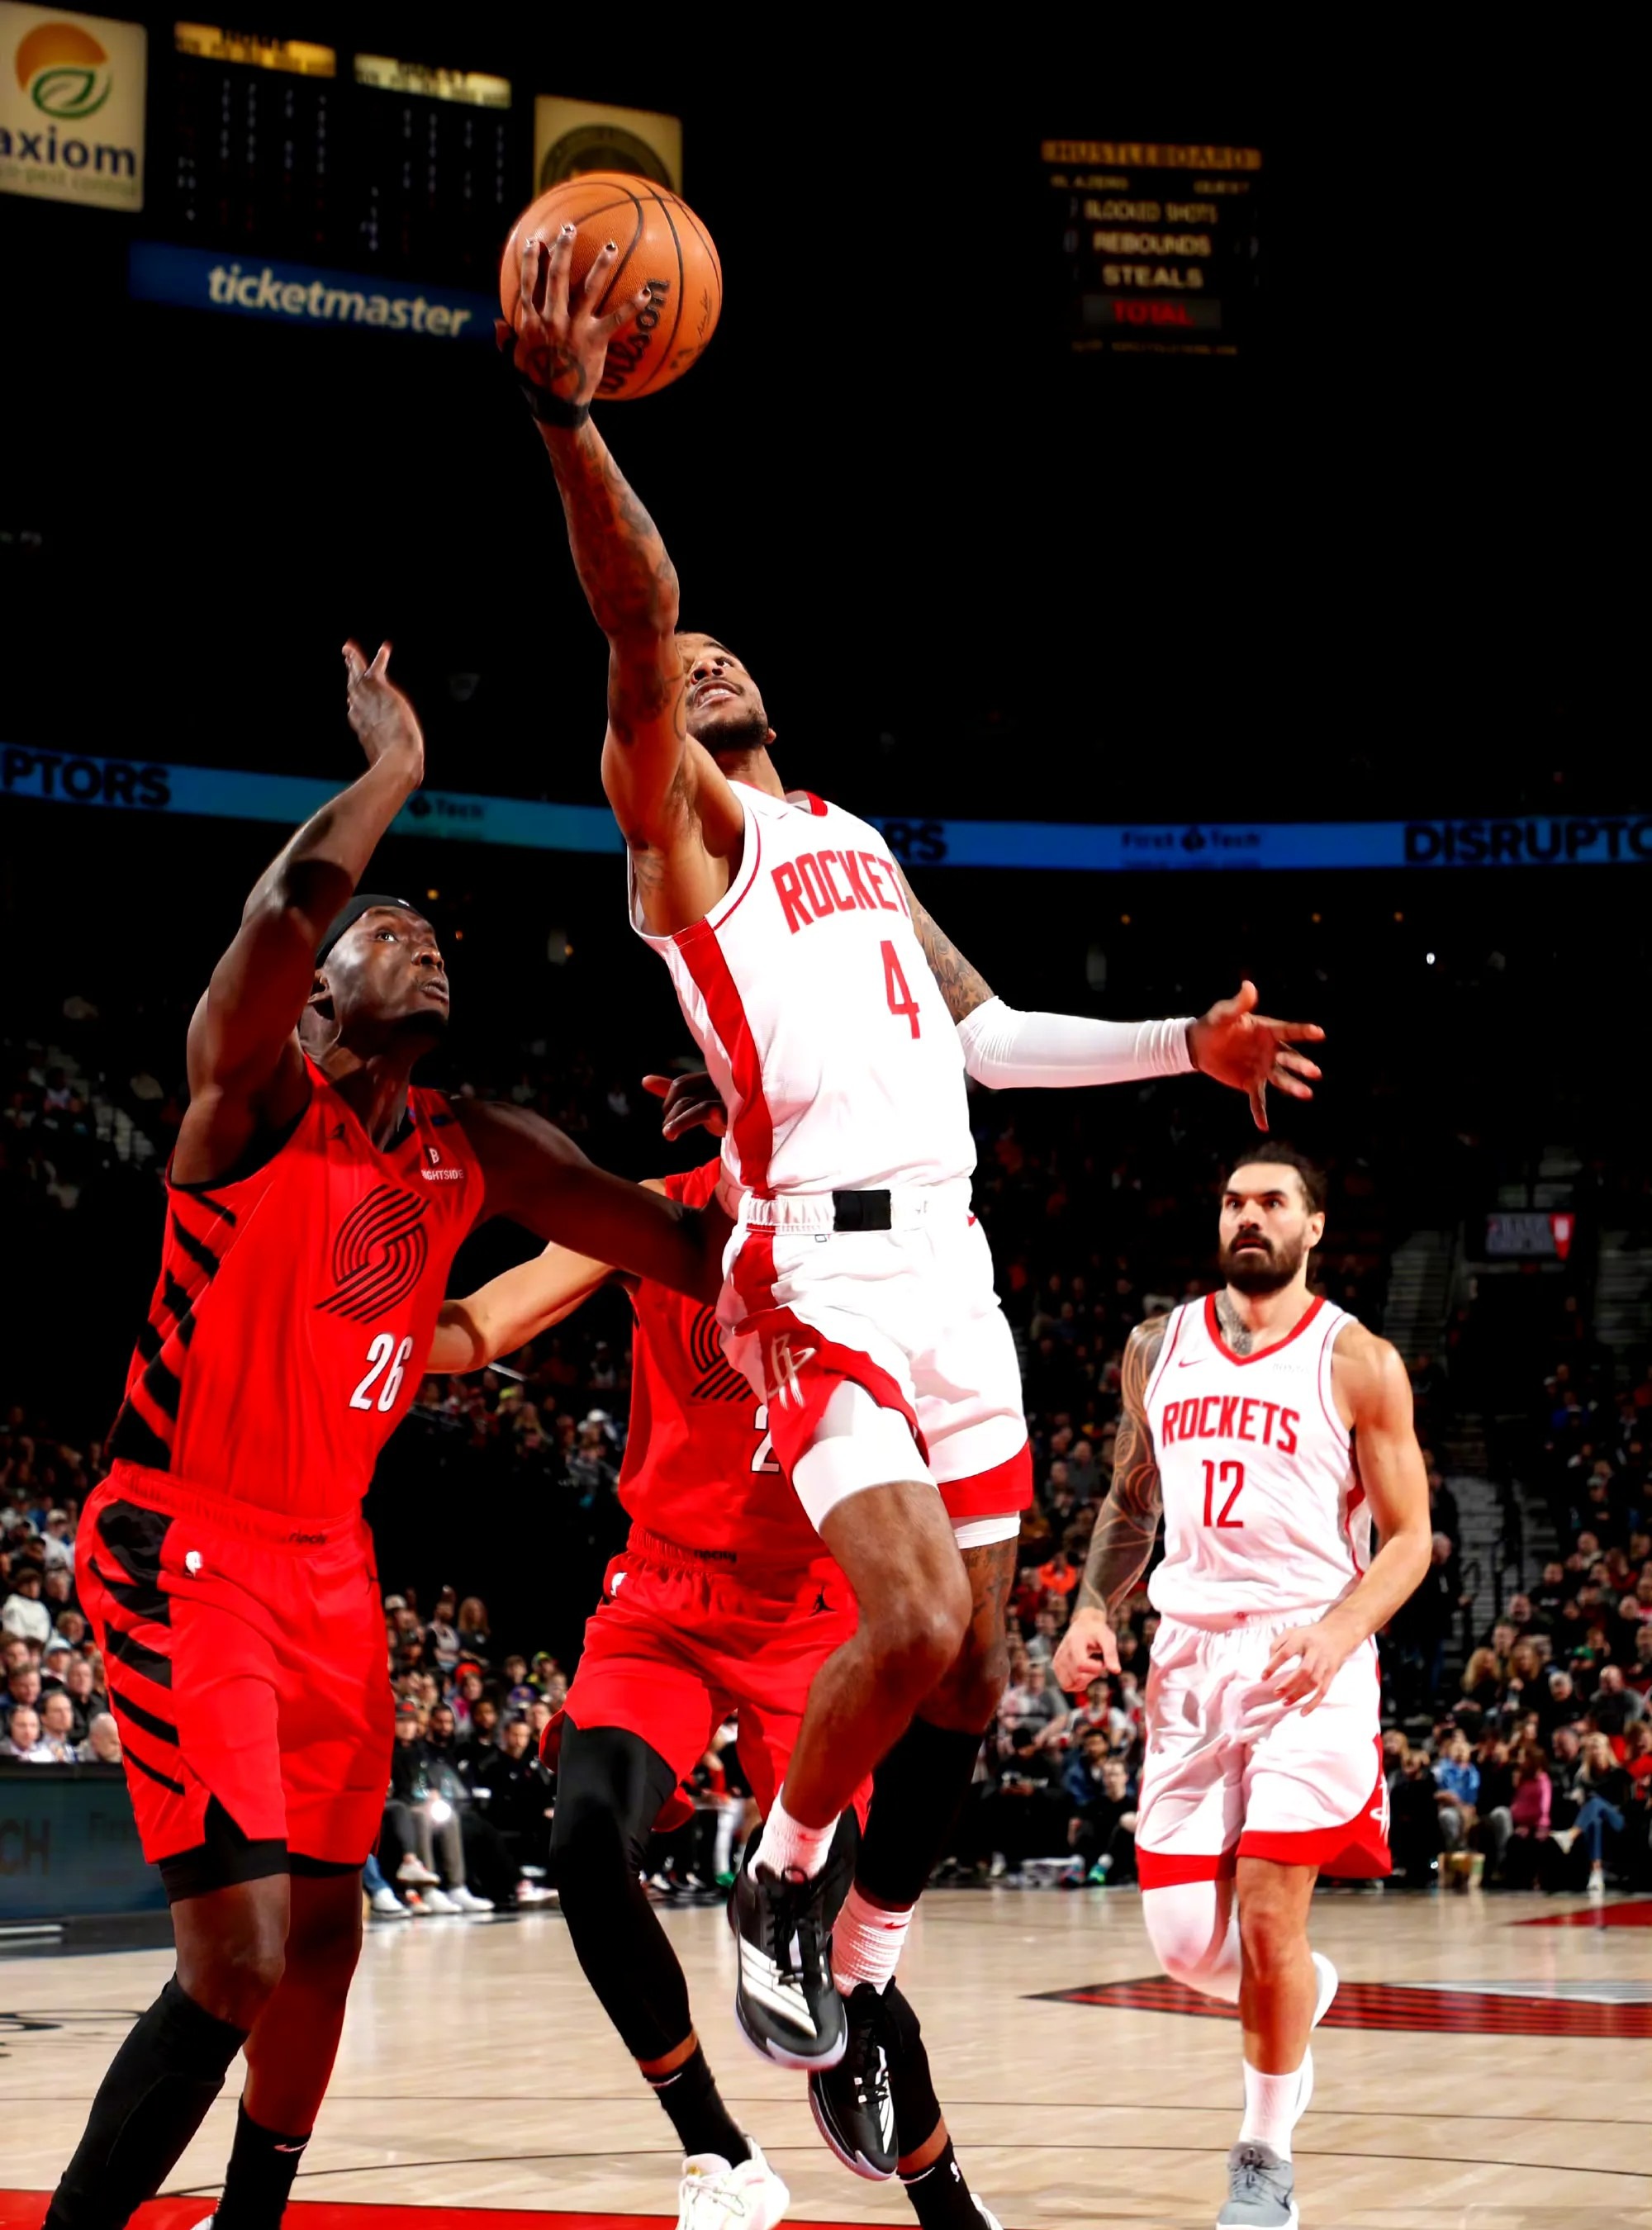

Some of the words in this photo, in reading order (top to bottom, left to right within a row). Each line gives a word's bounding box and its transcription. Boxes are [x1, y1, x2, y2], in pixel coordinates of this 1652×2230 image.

[0, 125, 135, 177] axiom
[1092, 230, 1213, 258] REBOUNDS
[207, 263, 472, 339] ticketmaster
[1101, 263, 1206, 289] STEALS
[1112, 299, 1195, 328] TOTAL
[4, 750, 170, 806] PTORS
[880, 940, 921, 1039] 4
[349, 1331, 414, 1412] 26
[1161, 1395, 1301, 1455] ROCKETS
[1202, 1459, 1245, 1528] 12
